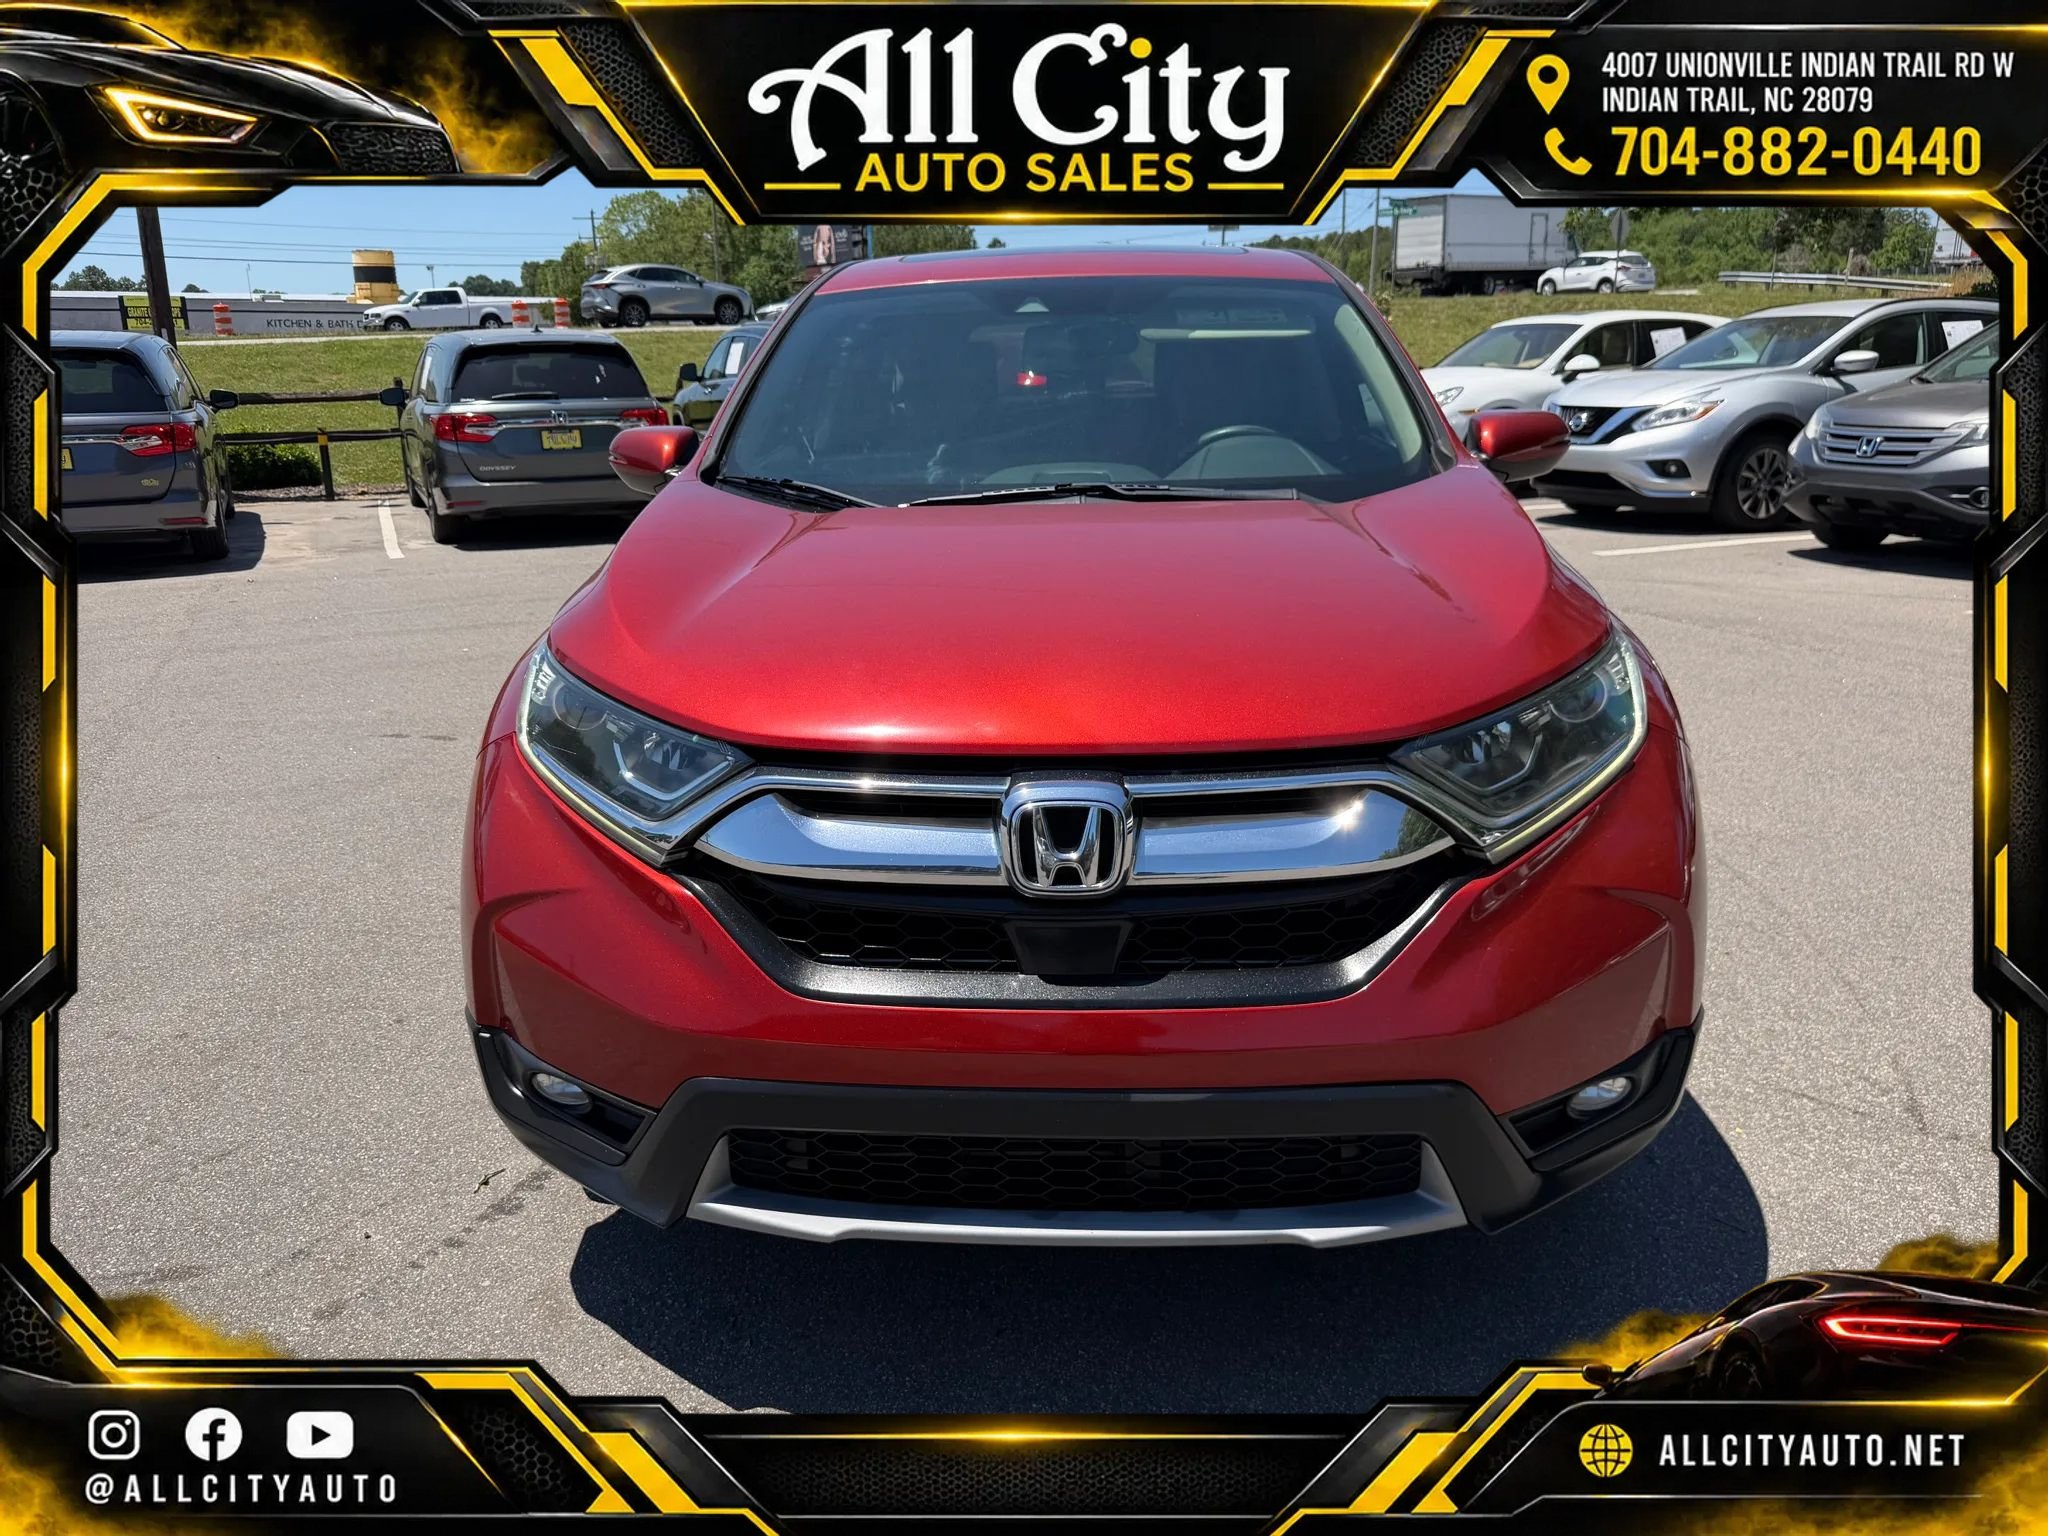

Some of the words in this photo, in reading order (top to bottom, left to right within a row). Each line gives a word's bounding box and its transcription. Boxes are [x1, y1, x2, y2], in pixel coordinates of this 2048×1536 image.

[266, 319, 312, 328] KITCHEN
[315, 320, 323, 328] &
[327, 320, 353, 329] BATH
